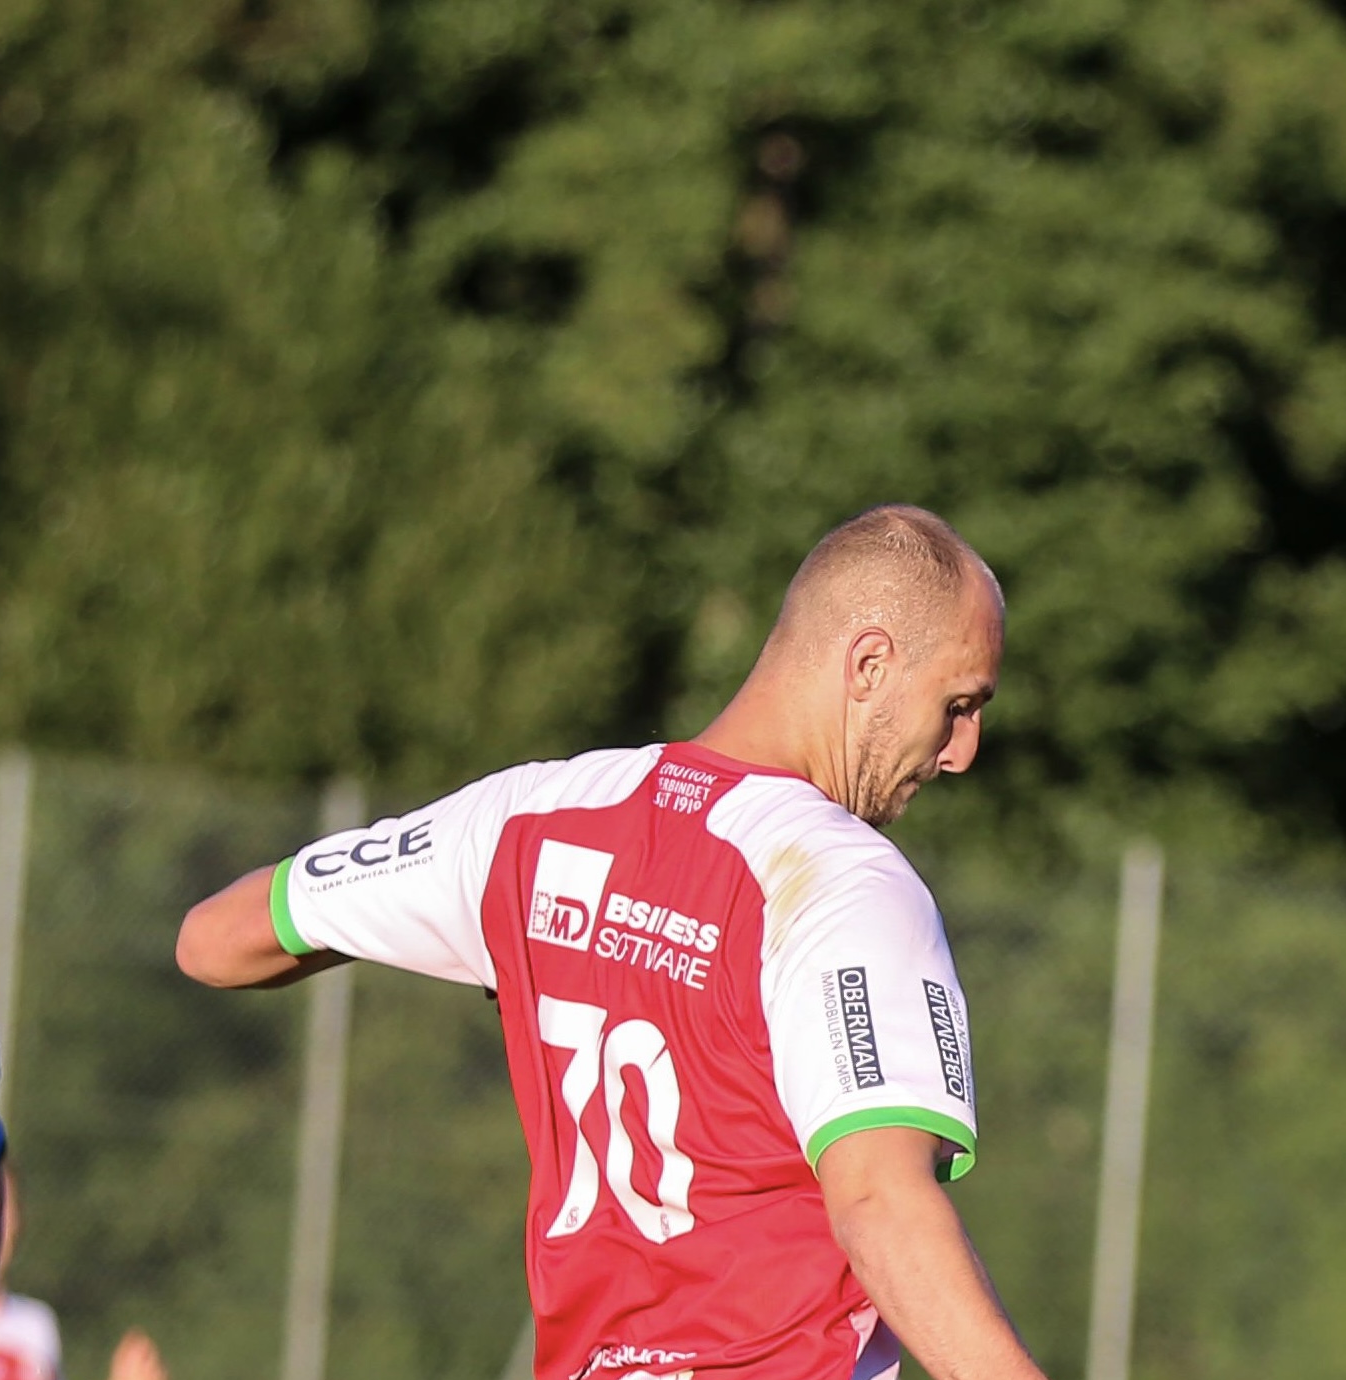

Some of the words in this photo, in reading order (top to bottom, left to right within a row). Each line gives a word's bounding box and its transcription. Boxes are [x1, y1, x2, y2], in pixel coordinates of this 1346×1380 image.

[305, 820, 434, 877] CCE
[347, 868, 390, 884] CAPITAL
[395, 855, 434, 873] ENERGY
[821, 970, 844, 1051] IMMOBILIEN
[834, 1054, 853, 1094] GMBH
[840, 969, 881, 1087] OBERMAIR
[926, 982, 964, 1098] OBERMAIR
